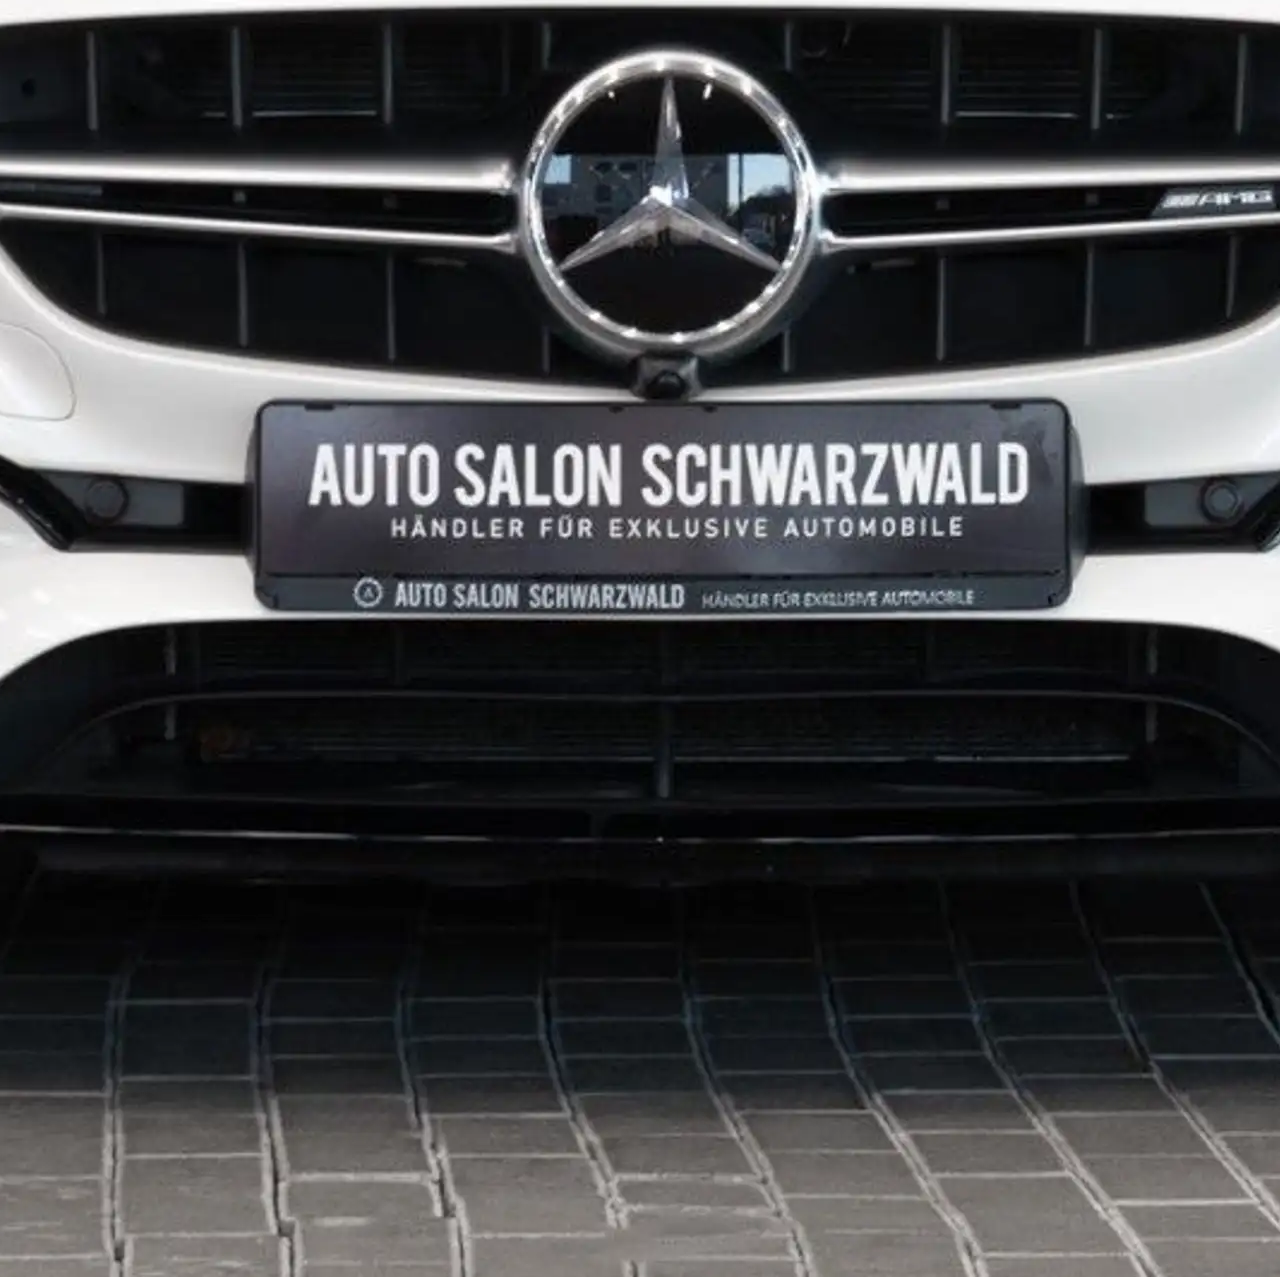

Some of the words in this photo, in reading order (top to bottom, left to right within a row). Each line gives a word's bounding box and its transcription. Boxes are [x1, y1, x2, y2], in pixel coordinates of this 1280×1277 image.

[308, 443, 441, 507] AUTO
[453, 443, 622, 508] SALON
[640, 441, 1030, 507] SCHWARZWALD
[391, 514, 524, 538] HÄNDLER
[540, 514, 593, 538] FÜR
[609, 517, 769, 539] EXKLUSIVE
[783, 516, 965, 538] AUTOMOBILE
[394, 582, 447, 608] AUTO
[453, 582, 519, 609] SALON
[528, 582, 685, 609] SCHWARZWALD
[702, 590, 769, 609] HÄNDLER
[773, 590, 800, 608] FÜR
[881, 589, 975, 606] AUTOMOBILE
